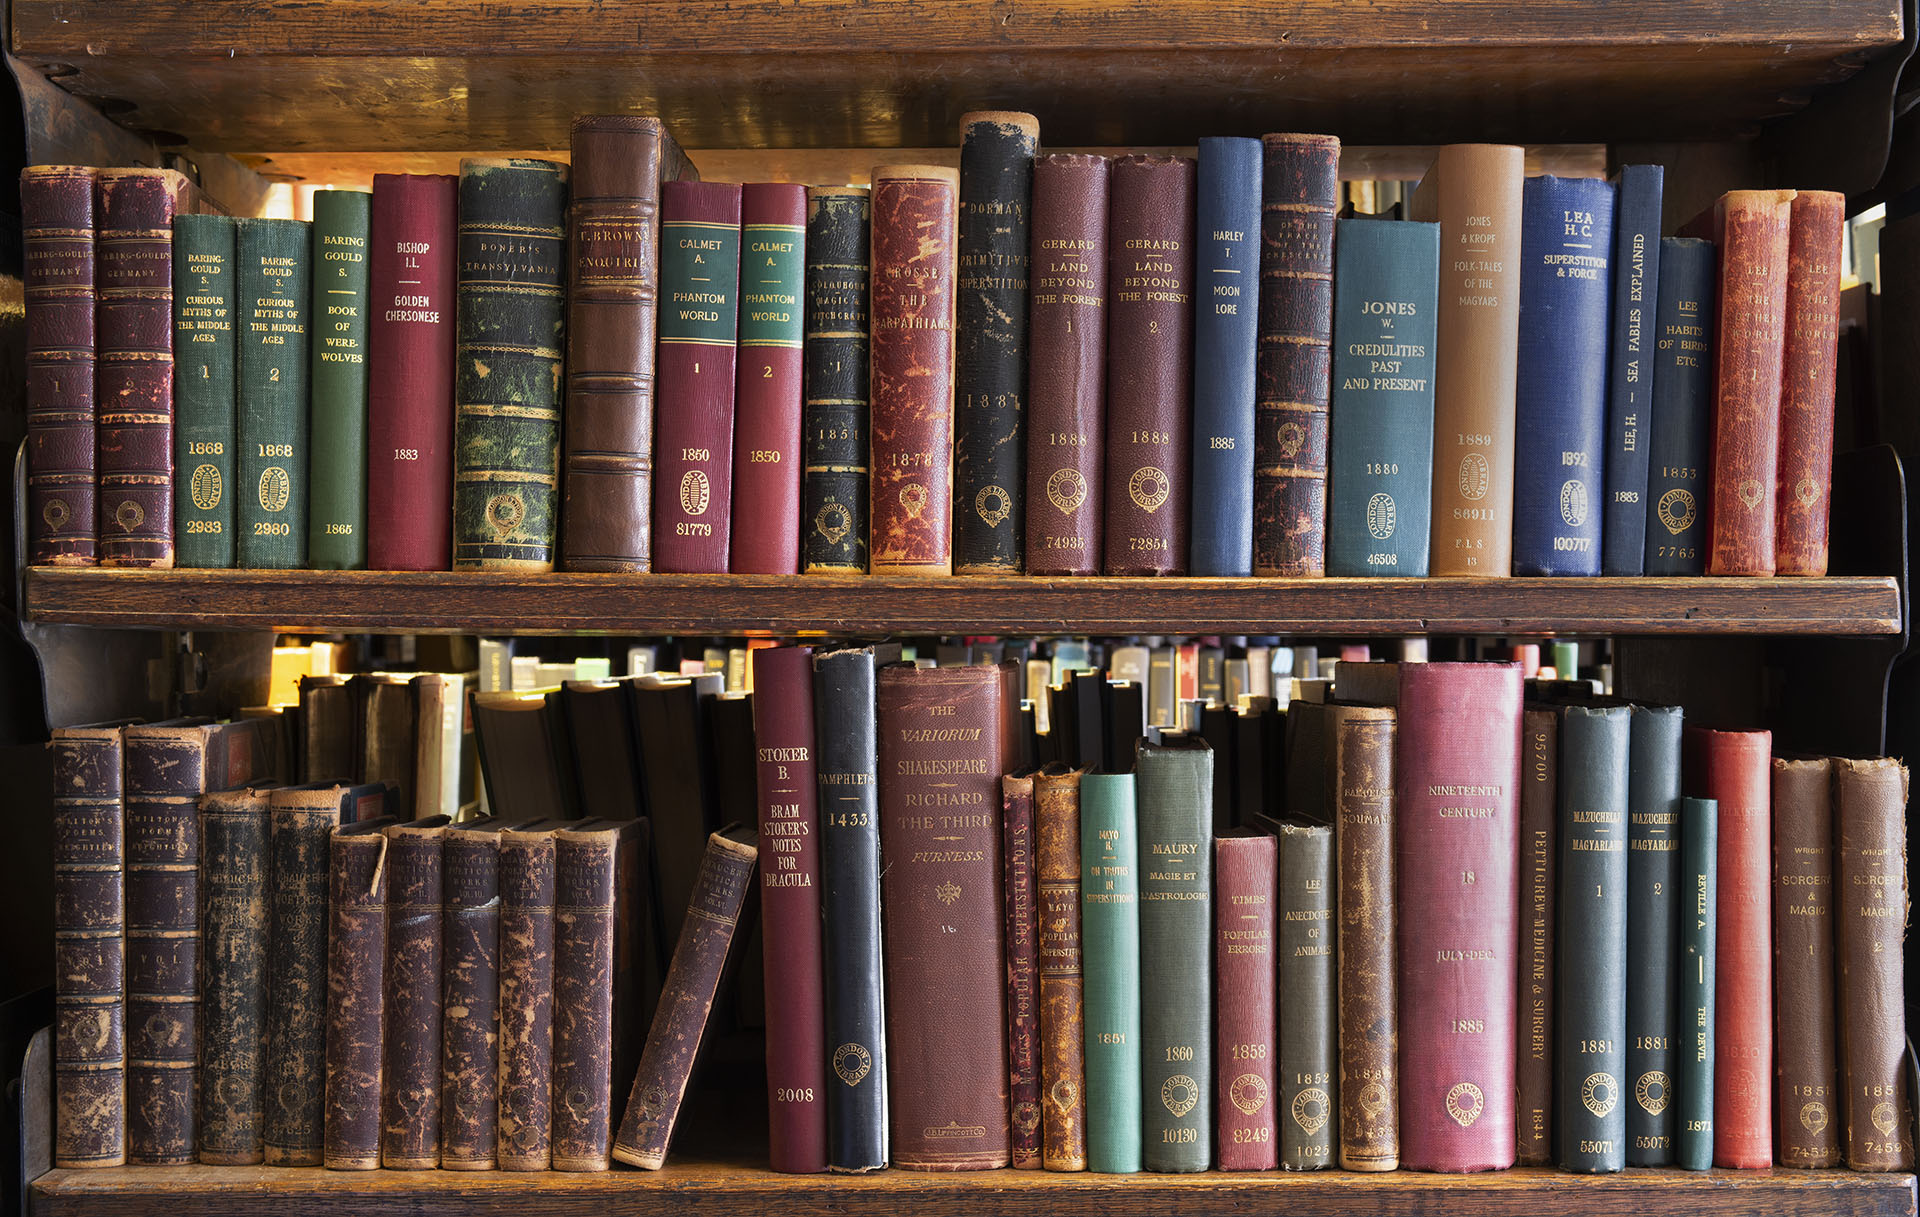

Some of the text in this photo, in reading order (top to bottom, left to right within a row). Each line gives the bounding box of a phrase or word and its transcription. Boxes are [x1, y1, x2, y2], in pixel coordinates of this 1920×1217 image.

[971, 203, 1022, 215] DORMAN
[1465, 216, 1491, 227] JONES
[1564, 211, 1594, 224] LEA
[324, 236, 364, 247] BARING
[1213, 230, 1244, 243] HARLEY
[1469, 233, 1496, 245] KROPF
[397, 242, 429, 254] BISHOP
[481, 243, 541, 255] BONER'S
[679, 239, 722, 251] CALMET
[1042, 239, 1095, 251] GERARD
[188, 254, 225, 264] BARING-
[325, 251, 362, 262] GOULD
[1544, 254, 1607, 268] SUPERSTITION
[191, 266, 221, 275] GOULD
[464, 262, 556, 275] TRANSYLVANIA
[1051, 261, 1089, 274] LAND
[1454, 260, 1503, 273] FOLK-TALES
[1748, 267, 1768, 275] LEE
[1810, 265, 1828, 274] LEE
[1568, 267, 1597, 281] FORCE
[1040, 276, 1095, 290] BEYOND
[1464, 278, 1493, 290] OF THE
[1214, 285, 1240, 298] MOON
[186, 296, 224, 305] CURIOUS
[395, 295, 429, 308] GOLDEN
[673, 292, 725, 305] PHANTOM
[1035, 292, 1102, 308] THE FOREST
[1459, 295, 1498, 308] MAGYARS
[183, 308, 227, 317] MYTHS OF
[328, 306, 357, 317] BOOK
[1216, 302, 1237, 316] LORE
[1362, 302, 1416, 316] JONES
[1679, 301, 1698, 312] LEE
[386, 310, 440, 324] CHERSONESE
[679, 310, 719, 323] WORLD
[178, 322, 231, 330] THE MIDDLE
[335, 322, 350, 332] OF
[1666, 325, 1703, 337] HABITS
[193, 334, 216, 342] AGES
[326, 337, 359, 348] WERE-
[1624, 234, 1645, 452] LEE, SEA FABLES EXPLAINED
[1350, 344, 1425, 359] CREDULITIES
[1659, 340, 1674, 350] OF
[321, 352, 363, 364] WOLVES
[1677, 356, 1699, 368] ETC.
[763, 365, 773, 378] 2
[1372, 361, 1402, 373] PAST
[270, 368, 279, 381] 2
[1344, 378, 1427, 392] AND PRESENT
[1050, 432, 1087, 446] 1888
[1131, 431, 1169, 445] 1888
[1210, 437, 1235, 450] 1885
[1458, 434, 1491, 447] 1889
[189, 442, 223, 454] 1868
[259, 444, 293, 457] 1868
[394, 449, 418, 461] 1883
[682, 448, 709, 462] 1850
[751, 450, 780, 464] 1850
[1562, 451, 1587, 466] 1892
[1367, 463, 1398, 475] 1880
[1663, 467, 1697, 480] 1853
[1049, 468, 1085, 490] LONDON
[192, 467, 222, 507] LONDON LIBRARY
[1050, 491, 1087, 509] LIBRARY
[1615, 492, 1638, 504] 1883
[1368, 494, 1396, 537] LONDON LIBRARY
[1454, 508, 1495, 521] 86911
[187, 521, 222, 533] 2983
[255, 523, 289, 536] 2980
[325, 524, 352, 535] 1865
[676, 522, 712, 537] 81779
[1046, 536, 1084, 550] 74935
[1130, 537, 1168, 551] 72854
[1553, 537, 1590, 551] 100717
[1368, 553, 1397, 566] 46508
[1659, 547, 1695, 559] 7765
[929, 706, 956, 716] THE
[900, 728, 982, 743] VARIORUM
[759, 748, 809, 762] STOKER
[1535, 734, 1547, 782] 95700
[898, 757, 987, 775] SHAKESPEARE
[1429, 785, 1502, 797] NINETEENTH
[906, 792, 983, 807] RICHARD
[771, 805, 800, 819] BRAM
[1439, 807, 1495, 819] CENTURY
[829, 813, 871, 827] 1433.
[898, 814, 993, 829] THE THIRD
[765, 822, 809, 836] STOKER'S
[1100, 831, 1119, 839] MAYO
[772, 838, 802, 853] NOTES
[1153, 844, 1198, 854] MAURY
[912, 849, 985, 864] FURNESS.
[778, 857, 797, 871] FOR
[1091, 866, 1128, 876] ON TRUTHS
[1150, 873, 1197, 881] MAGIE ET
[766, 873, 812, 888] DRACULA
[1306, 880, 1321, 889] LEE
[1654, 883, 1663, 895] 2
[1141, 892, 1208, 900] L'ASTROLOGIE
[1232, 896, 1266, 905] TIMBS
[1790, 905, 1825, 915] MAGIC
[1044, 933, 1078, 941] POPULAR
[1224, 930, 1268, 940] POPULAR
[1309, 929, 1320, 938] OF
[1228, 945, 1267, 954] ERRORS
[1295, 945, 1331, 956] ANIMALS
[1436, 949, 1496, 963] JULY-DEC.
[1697, 874, 1707, 1062] REVILLE A. THE DEVIL
[1017, 956, 1030, 1018] POPULAR
[1451, 1019, 1484, 1034] 1885
[1533, 999, 1544, 1060] SURGERY
[1097, 1033, 1126, 1046] 1851
[1232, 1045, 1266, 1059] 1858
[1581, 1040, 1614, 1053] 1881
[1165, 1046, 1192, 1062] 1860
[1297, 1073, 1330, 1084] 1852
[1584, 1073, 1615, 1093] LONDON
[778, 1088, 814, 1103] 2008
[1793, 1086, 1829, 1096] 1851
[1583, 1094, 1618, 1114] LIBRARY
[1533, 1109, 1543, 1140] 1844
[1687, 1119, 1712, 1132] 1871
[1162, 1129, 1197, 1143] 10130
[1234, 1128, 1269, 1143] 8249
[1297, 1145, 1330, 1158] 1025
[1580, 1140, 1614, 1153] 55071
